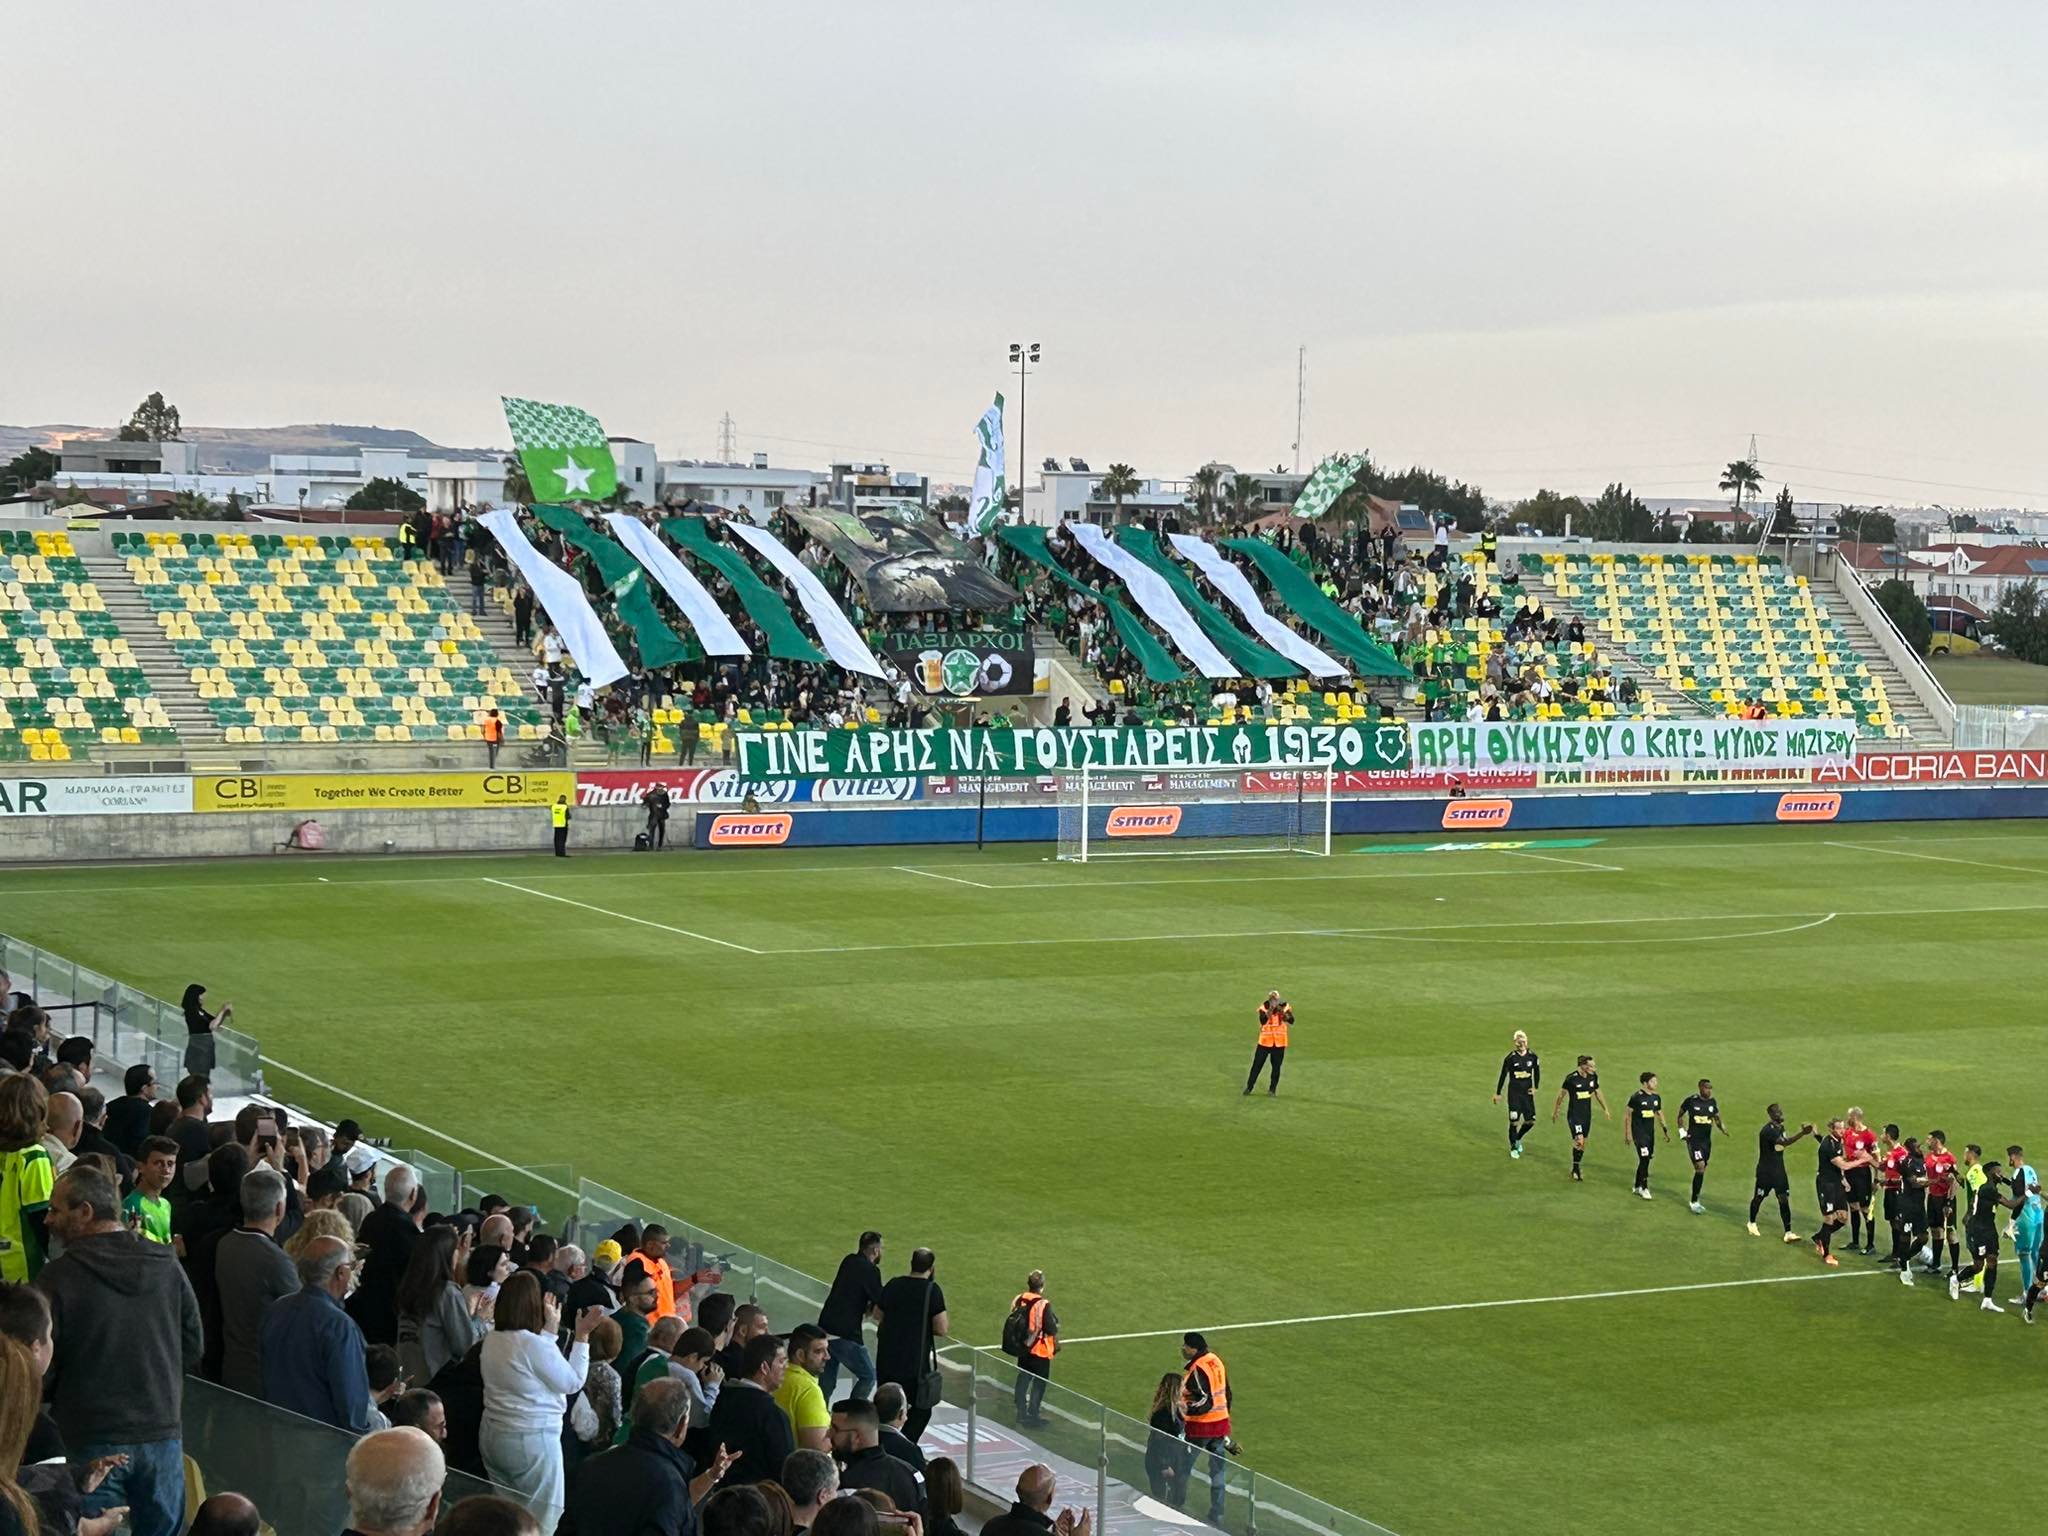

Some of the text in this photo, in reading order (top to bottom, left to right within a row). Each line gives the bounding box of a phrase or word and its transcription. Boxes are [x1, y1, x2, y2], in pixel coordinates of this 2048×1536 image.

[891, 632, 1025, 652] ΤΑΞΙΑΡΧΟΙ
[738, 726, 1365, 776] ΓΙΝΕ ΑΡΗΣ ΝΑ ΓΟΥΣΤΑΡΕΙΣ 1930
[1418, 727, 1476, 771] ΑΡΗ
[1487, 725, 1612, 764] ΘΥΜΗΣΟΥ
[1646, 725, 1707, 758] ΚΑΤΩ
[1817, 753, 1966, 782] ANCORIA
[215, 778, 258, 799] CB
[314, 786, 464, 800] Together We Create Better
[482, 775, 523, 795] CB
[1447, 806, 1506, 820] smart
[1781, 800, 1836, 813] smart
[716, 822, 784, 836] smart
[1113, 814, 1173, 827] smart
